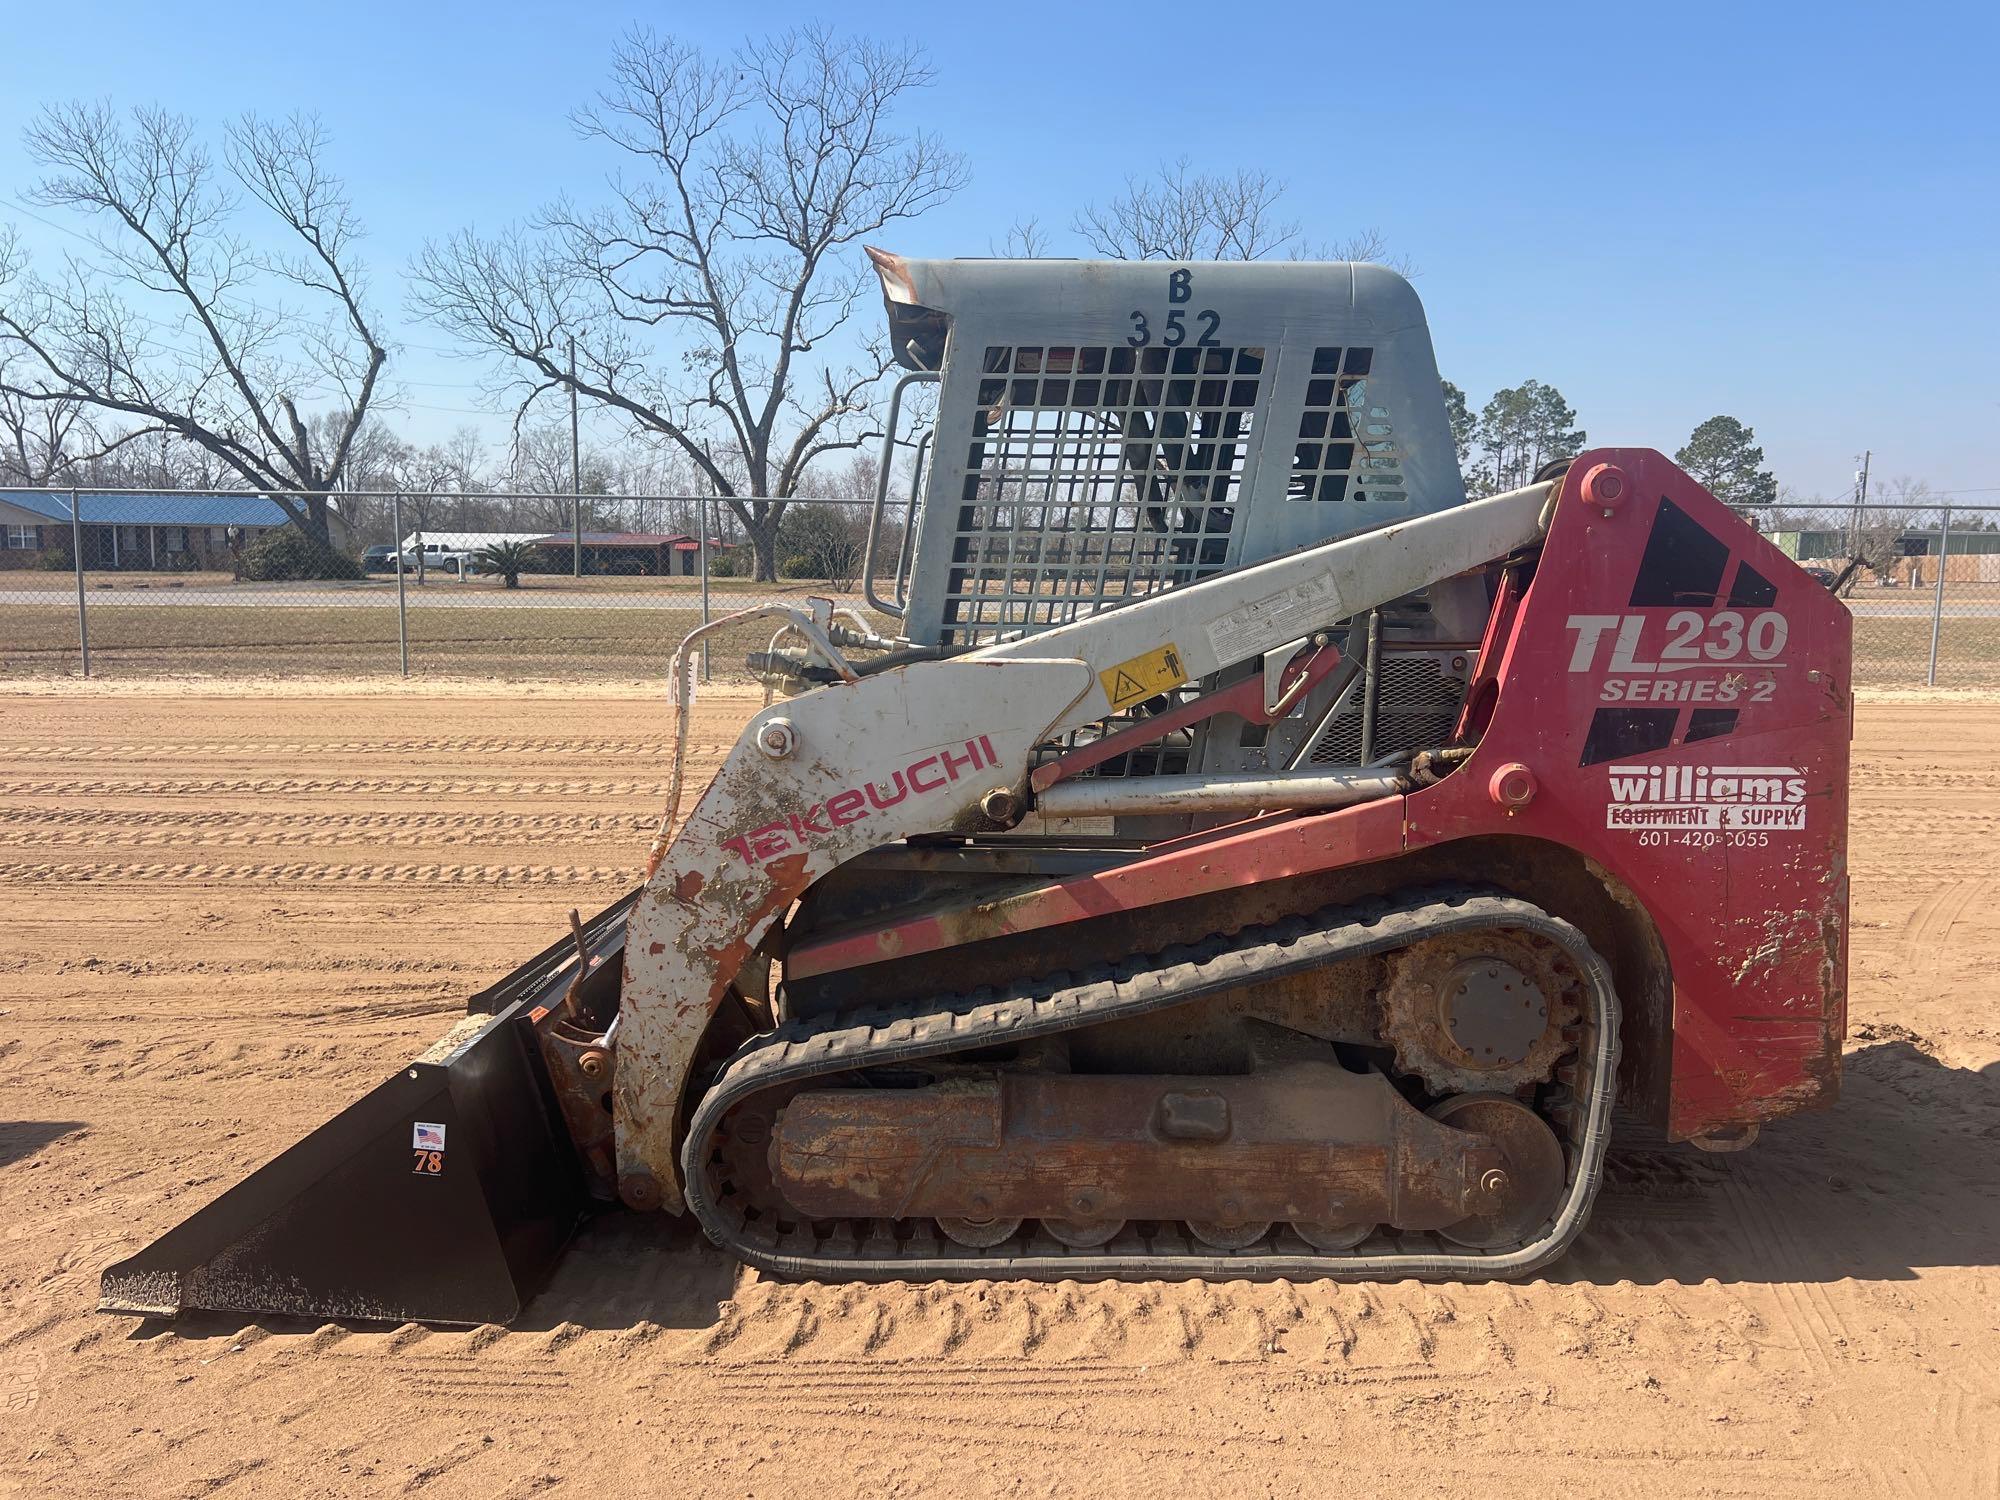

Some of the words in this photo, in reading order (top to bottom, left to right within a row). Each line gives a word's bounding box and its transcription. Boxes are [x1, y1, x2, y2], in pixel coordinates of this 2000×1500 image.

[1169, 268, 1192, 303] B
[1600, 679, 1740, 702] SERIES
[1749, 680, 1777, 702] 2
[1608, 765, 1807, 803] williams
[1611, 807, 1709, 825] EQUIPMENT
[1719, 807, 1731, 825] &
[1741, 808, 1803, 825] SUPPLY
[413, 1150, 442, 1173] 78
